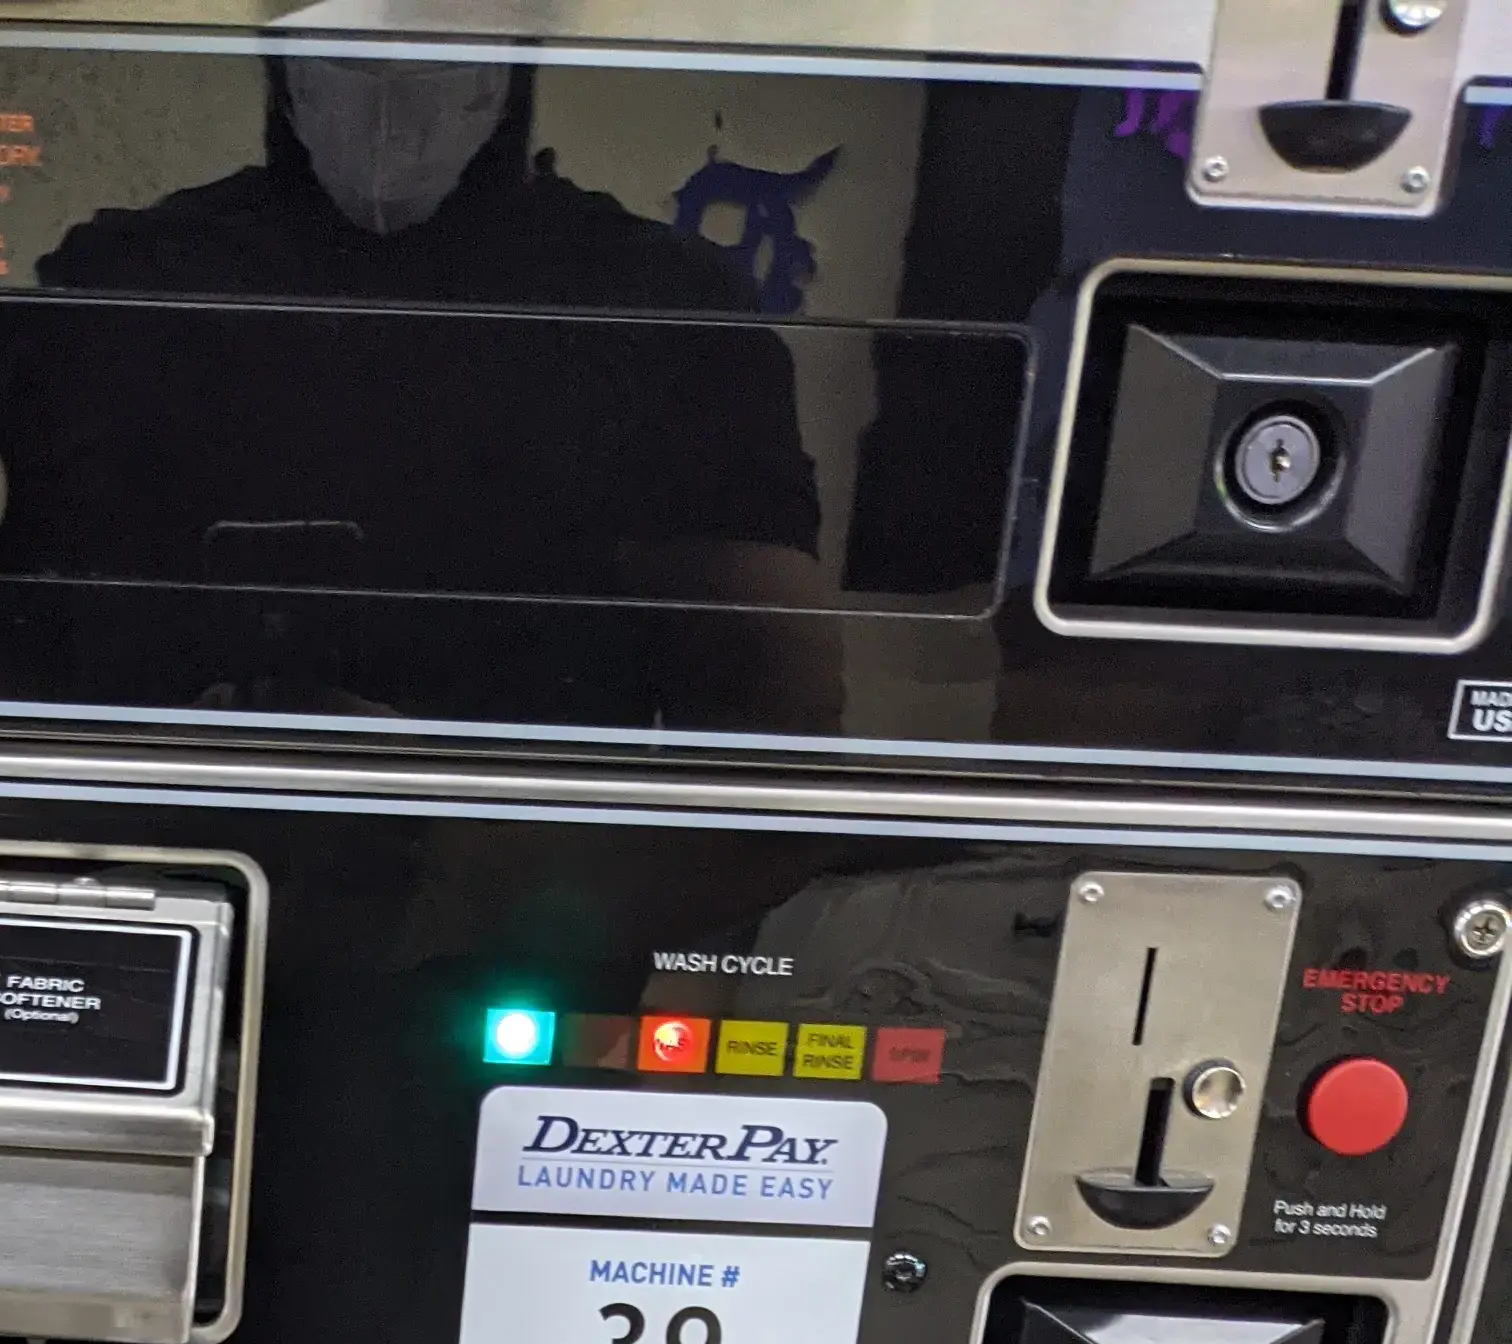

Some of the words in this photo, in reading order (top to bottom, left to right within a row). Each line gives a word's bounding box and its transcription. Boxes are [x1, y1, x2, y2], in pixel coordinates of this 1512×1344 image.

[653, 951, 717, 973] WASH
[721, 954, 793, 976] CYCLE
[6, 975, 84, 992] FABRIC
[1303, 968, 1451, 995] EMERGENCY
[1340, 994, 1404, 1014] STOP
[727, 1040, 778, 1056] RINSE
[808, 1032, 854, 1050] FINAL
[802, 1054, 854, 1069] RINSE
[518, 1165, 656, 1193] LAUNDRY
[666, 1171, 747, 1196] MADE
[761, 1176, 834, 1200] EASY
[1273, 1200, 1313, 1218] Push
[1316, 1203, 1346, 1218] and
[1349, 1204, 1386, 1221] Hold
[1274, 1219, 1295, 1234] for
[1298, 1220, 1310, 1234] 3
[1312, 1223, 1378, 1238] seconds
[589, 1259, 714, 1287] MACHINE
